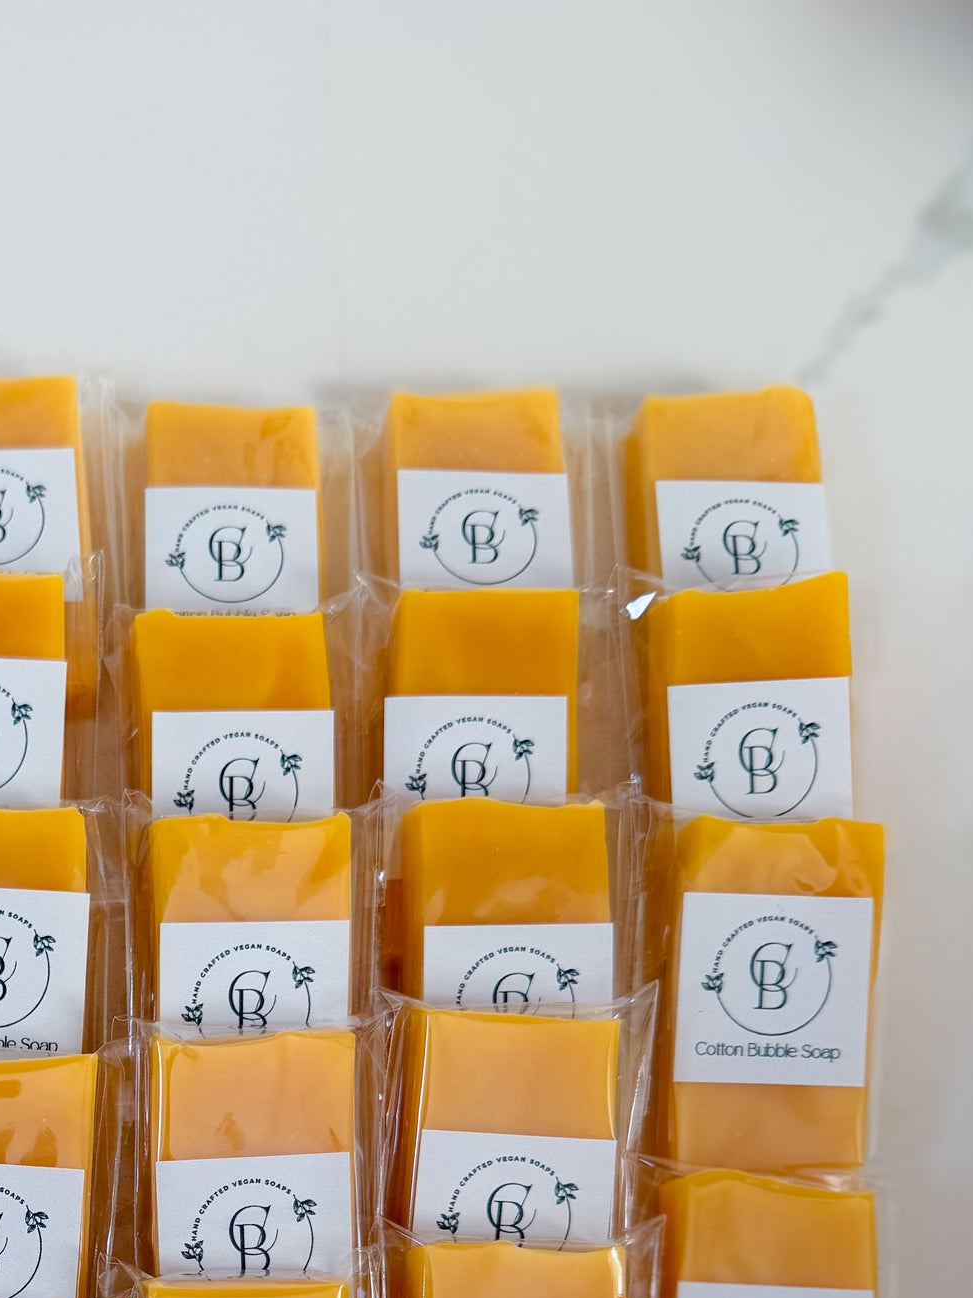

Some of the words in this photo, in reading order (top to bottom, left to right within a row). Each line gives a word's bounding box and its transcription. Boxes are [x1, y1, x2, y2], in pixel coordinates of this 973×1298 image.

[703, 738, 713, 764] HAND
[710, 707, 739, 738] CRAFTED
[740, 701, 769, 711] VEGAN
[771, 703, 798, 718] SOAPS
[7, 911, 33, 929] SOAPS
[191, 979, 202, 1006] HAND
[200, 948, 231, 978] CRAFTED
[233, 942, 263, 952] VEGAN
[264, 945, 292, 962] SOAPS
[695, 1040, 744, 1056] Cotton
[747, 1042, 798, 1058] Bubble
[801, 1044, 841, 1063] Soap
[191, 1216, 201, 1243] HAND
[198, 1184, 230, 1215] CRAFTED
[231, 1177, 262, 1187] VEGAN
[263, 1179, 292, 1195] SOAPS
[448, 1188, 461, 1215] HAND
[459, 1159, 494, 1187] CRAFTED
[495, 1155, 527, 1163] VEGAN
[528, 1158, 556, 1177] SOAPS
